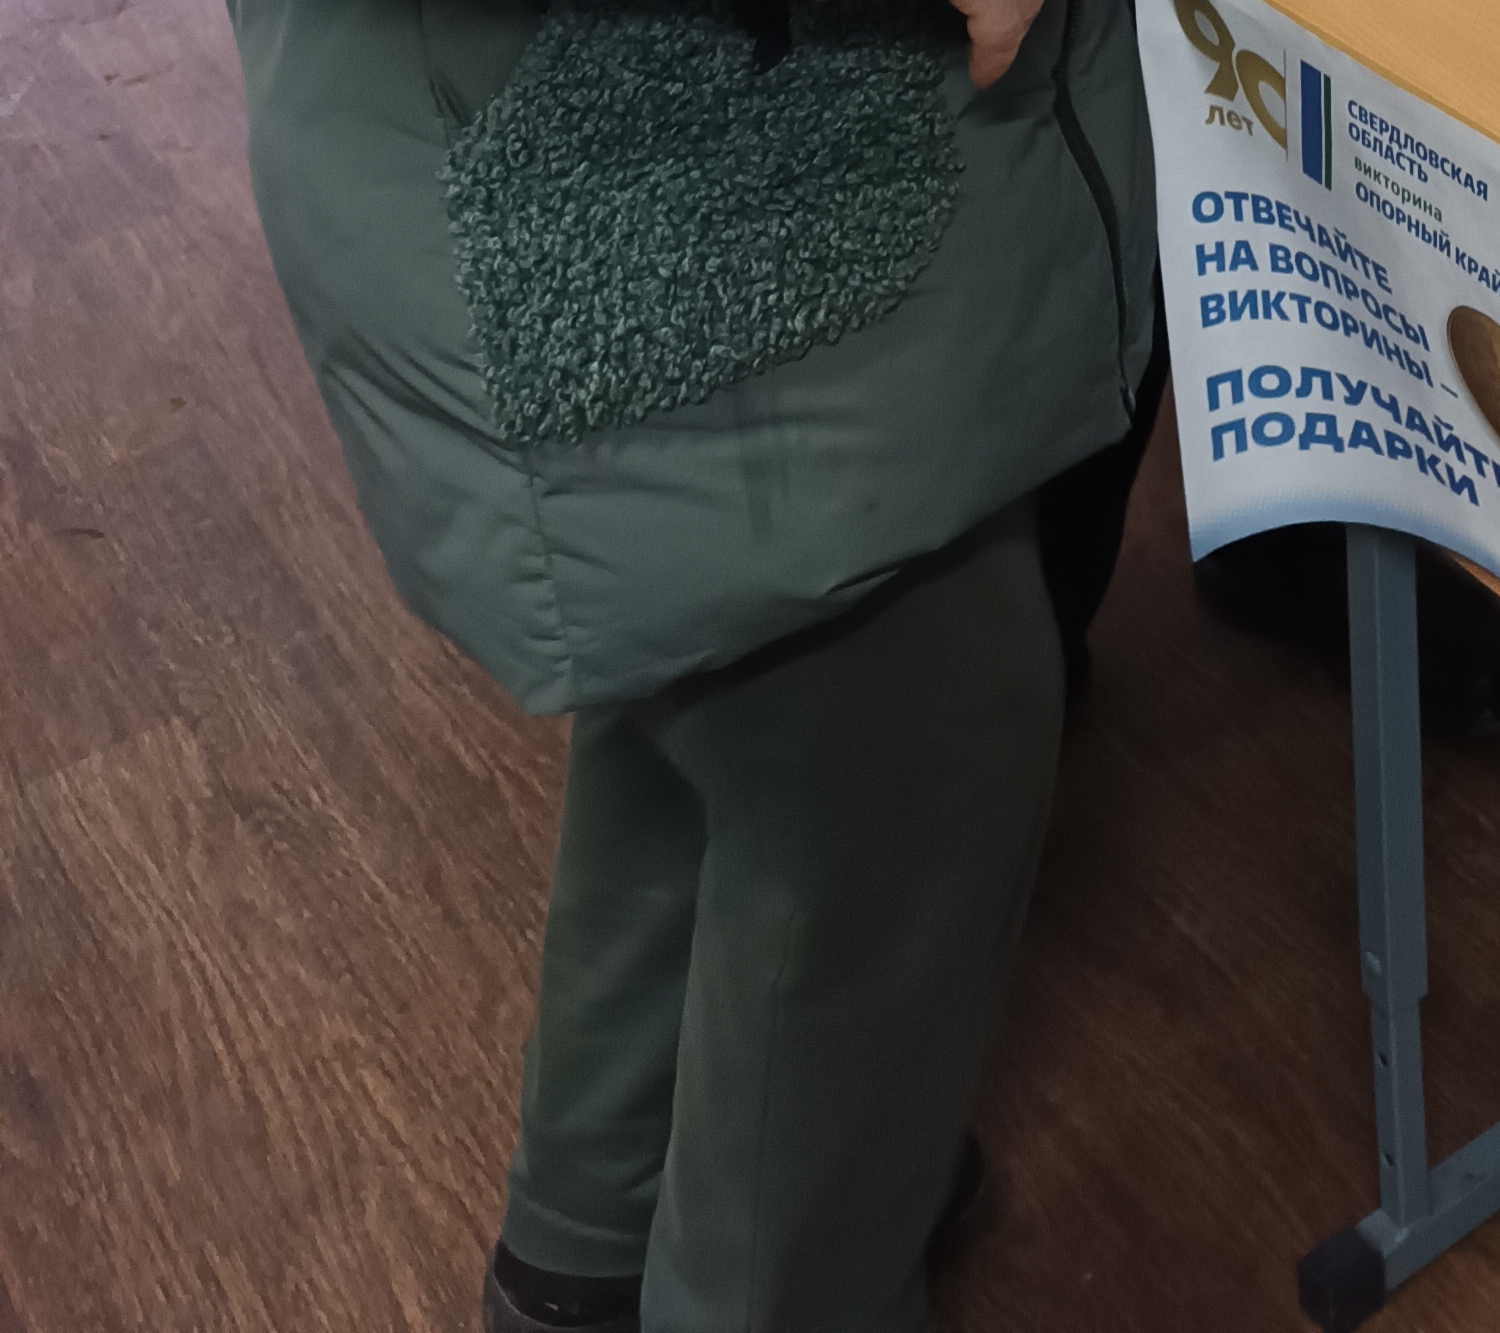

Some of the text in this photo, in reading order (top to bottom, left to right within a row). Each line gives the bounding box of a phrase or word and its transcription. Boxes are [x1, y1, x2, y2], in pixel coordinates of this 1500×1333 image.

[1205, 104, 1254, 136] лет
[1348, 100, 1488, 202] СВЕРДЛОВСКАЯ
[1348, 121, 1429, 183] ОБЛАСТЬ
[1354, 156, 1443, 223] викторина
[1355, 181, 1451, 258] ОПОРНЫЙ
[1192, 190, 1393, 296] ОТВЕЧАЙТЕ
[1196, 240, 1430, 352] НА ВОПРОСЫ
[1200, 289, 1434, 389] ВИКТОРИНЫ
[1211, 411, 1480, 507] ПОДАРКИ
